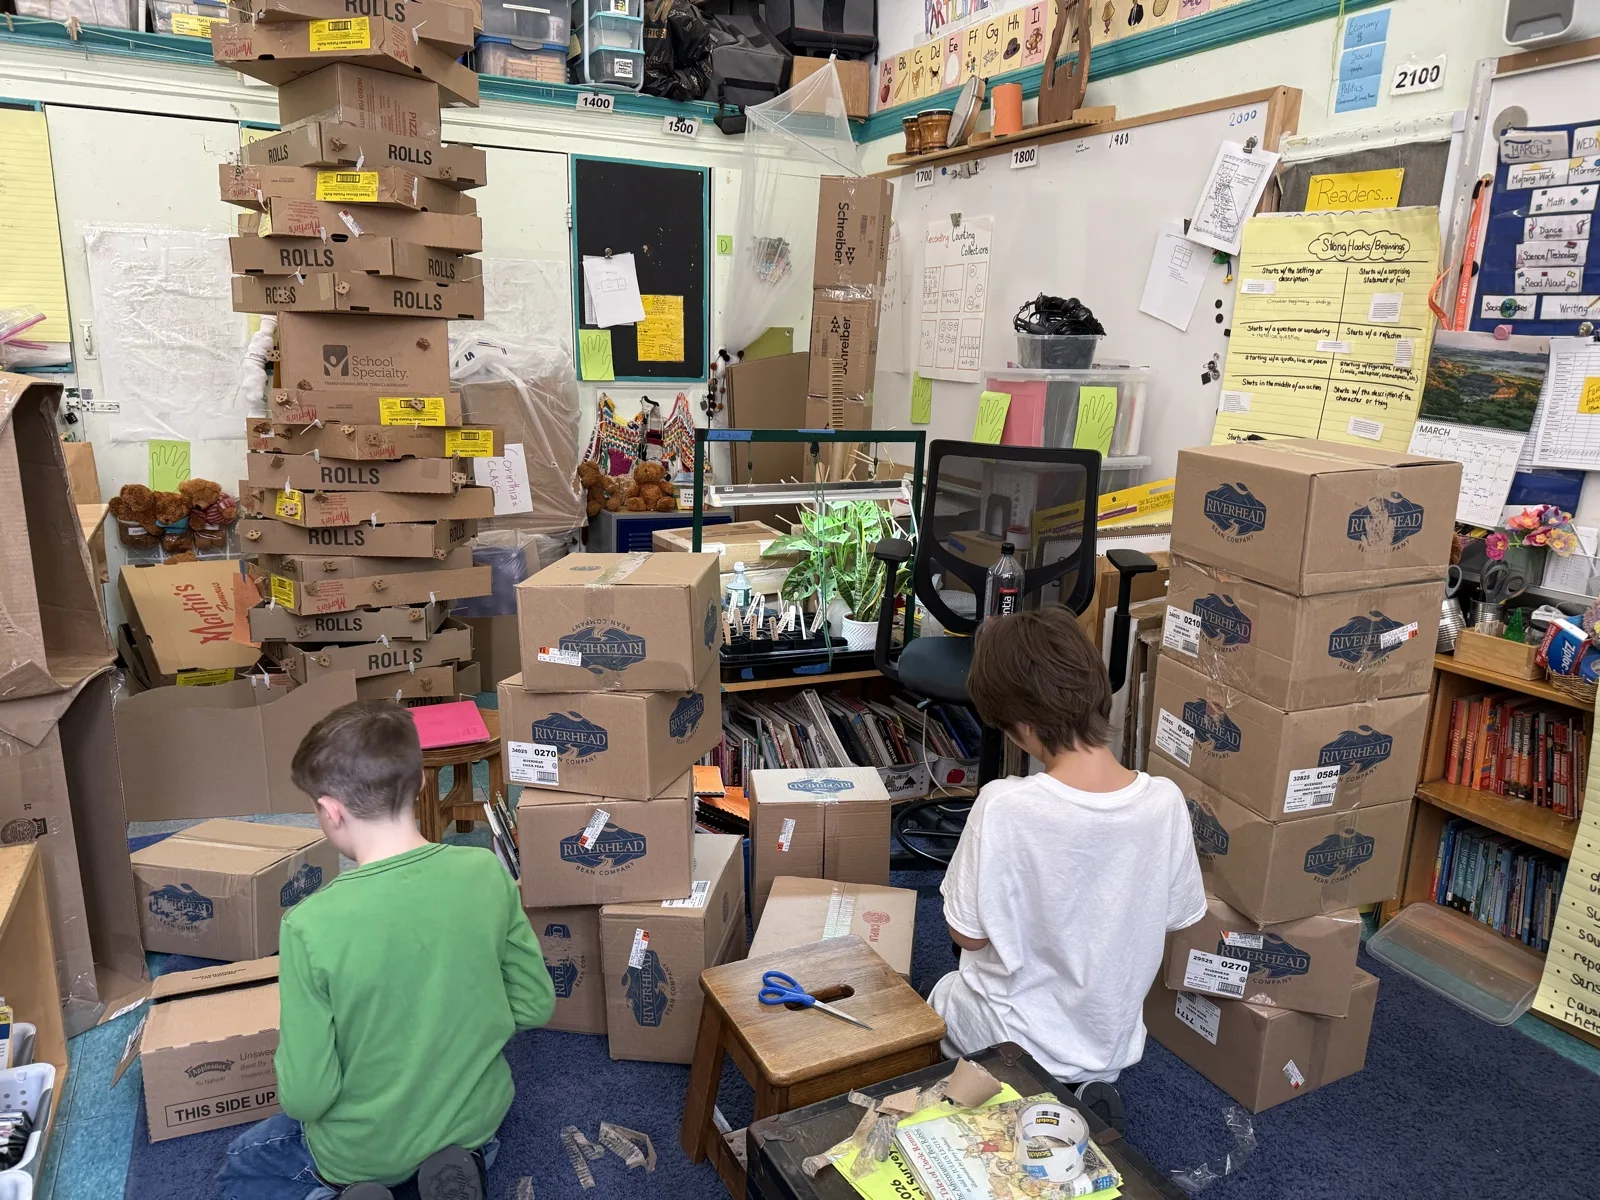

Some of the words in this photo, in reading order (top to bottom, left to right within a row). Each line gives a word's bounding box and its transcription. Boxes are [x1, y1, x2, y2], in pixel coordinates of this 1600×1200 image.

[985, 23, 999, 44] Gg
[1007, 17, 1020, 33] Hh
[948, 37, 959, 53] Ee
[968, 29, 978, 46] Ff
[914, 49, 924, 64] Cc
[930, 44, 941, 60] Dd
[883, 64, 893, 77] Aa
[898, 57, 908, 71] Bb
[1395, 65, 1441, 89] 2100
[1341, 81, 1364, 95] Politics
[582, 96, 610, 109] 1400
[1229, 109, 1257, 127] 2000
[668, 120, 693, 134] 1500
[268, 144, 289, 164] ROLLS
[388, 144, 433, 166] ROLLS
[1013, 149, 1035, 164] 1800
[1511, 142, 1543, 157] MARCH
[915, 169, 932, 183] 1700
[1511, 173, 1536, 184] Morning
[1538, 170, 1555, 181] Work
[1546, 196, 1565, 208] Math
[288, 219, 321, 236] Martin's
[834, 202, 849, 265] Schreiber
[1539, 226, 1563, 235] Dance
[926, 230, 949, 248] Recording
[951, 226, 976, 246] Counting
[721, 239, 728, 253] D
[961, 244, 989, 257] Collections
[1322, 237, 1347, 257] Strong
[280, 248, 335, 267] ROLLS
[428, 258, 455, 279] ROLLS
[1261, 267, 1280, 275] Starts
[1524, 278, 1542, 288] Read
[1544, 277, 1566, 288] Aloud
[393, 290, 443, 311] ROLLS
[1559, 303, 1588, 316] Writing
[1346, 328, 1364, 336] Starts
[352, 355, 394, 367] School
[1242, 379, 1259, 387] Starts
[1333, 385, 1351, 394] Starts
[1335, 395, 1363, 404] character
[1419, 425, 1451, 437] MARCH
[321, 466, 380, 485] ROLLS
[1205, 497, 1266, 525] RIVERHEAD
[308, 528, 365, 546] ROLLS
[1211, 525, 1226, 542] BEAN
[1226, 534, 1254, 544] COMPANY
[211, 582, 234, 611] Famous
[173, 582, 234, 645] Martin's
[1184, 615, 1200, 628] 0210
[1193, 602, 1251, 638] RIVERHEAD
[315, 617, 363, 632] ROLLS
[571, 618, 608, 633] COMPANY
[609, 619, 631, 632] BEAN
[561, 640, 643, 657] RIVERHEAD
[1561, 640, 1577, 671] Ziploc
[368, 647, 423, 671] ROLLS
[1338, 660, 1356, 672] BEAN
[669, 698, 704, 732] RIVERHEAD
[534, 726, 606, 746] RIVERHEAD
[1177, 723, 1194, 740] 0584
[1184, 710, 1240, 746] RIVERHEAD
[534, 747, 557, 758] 0270
[565, 754, 598, 765] COMPANY
[1203, 748, 1230, 759] COMPANY
[1321, 742, 1390, 764] RIVERHEAD
[1317, 768, 1339, 780] 0584
[1346, 766, 1378, 783] COMPANY
[1193, 820, 1227, 850] RHEAD
[563, 840, 645, 858] RIVERHEAD
[1307, 843, 1373, 867] RIVERHEAD
[575, 865, 596, 876] BEAN
[599, 861, 635, 876] COMPANY
[1313, 875, 1329, 884] BEAN
[1331, 866, 1361, 884] COMPANY
[1193, 954, 1213, 965] 29525
[1220, 943, 1308, 970] RIVERHEAD
[1221, 960, 1248, 972] 0270
[575, 970, 586, 988] BEAN
[661, 962, 677, 997] COMPANY
[1252, 976, 1293, 985] COMPANY
[642, 951, 655, 1026] RIVERHEAD
[665, 999, 675, 1016] BEAN
[257, 1061, 267, 1070] By
[174, 1105, 212, 1123] THIS
[214, 1096, 252, 1115] SIDE
[254, 1090, 277, 1107] UP
[1035, 1117, 1059, 1126] Scotch
[904, 1130, 920, 1152] Remus
[917, 1151, 932, 1171] Uncle
[1027, 1149, 1053, 1160] Scotch
[889, 1150, 915, 1185] Survey
[927, 1170, 937, 1179] of
[890, 1179, 916, 1200] 026
[936, 1177, 948, 1198] Tales
